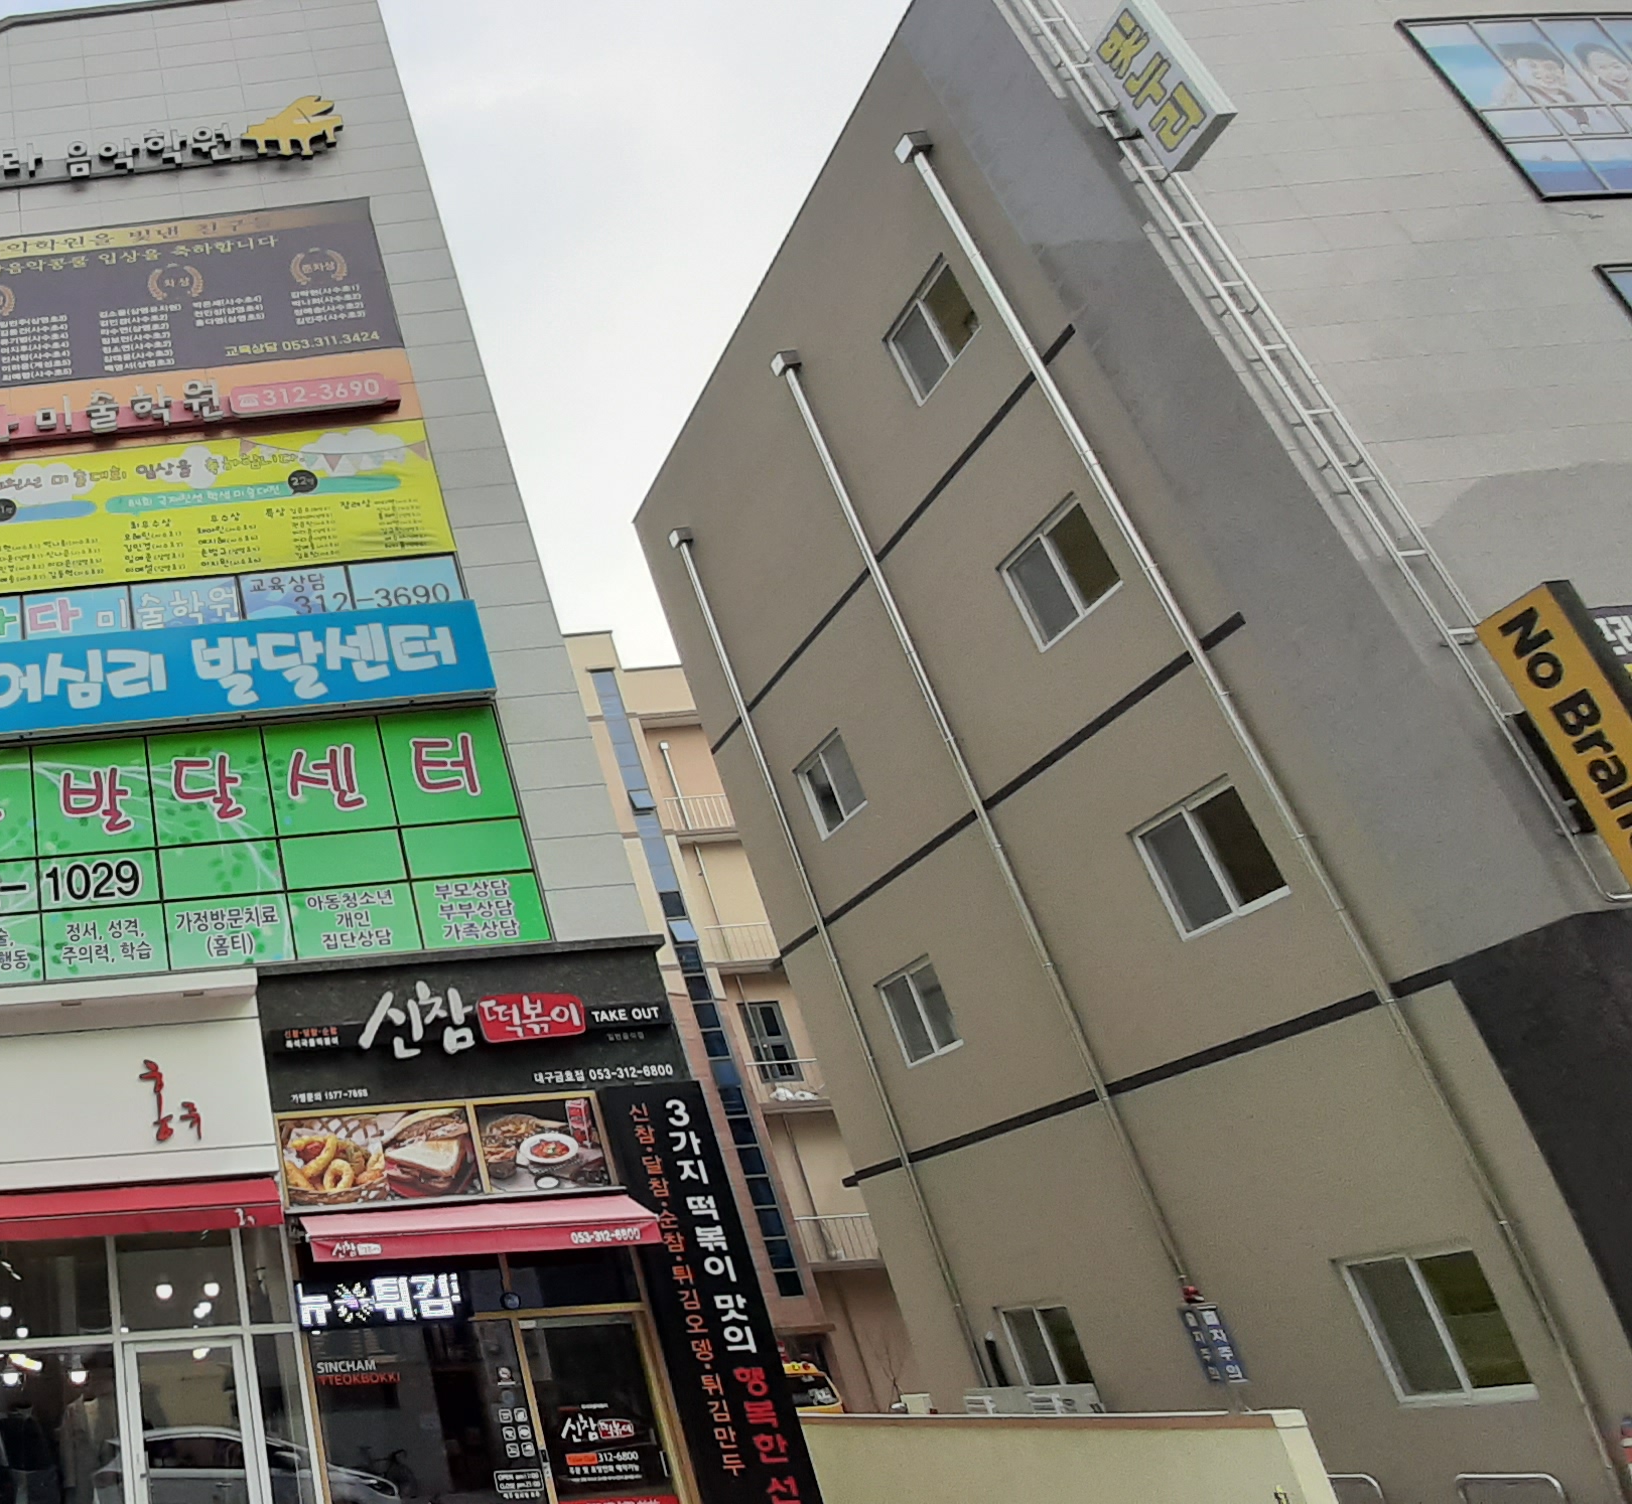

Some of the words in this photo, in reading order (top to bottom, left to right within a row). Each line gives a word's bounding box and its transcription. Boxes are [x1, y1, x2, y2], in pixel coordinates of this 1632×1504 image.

[67, 123, 233, 177] 음악학원
[281, 330, 380, 351] 053.311.3424
[35, 378, 224, 434] 미술학원
[263, 379, 381, 407] 312-3690
[135, 458, 192, 480] 입상을
[249, 573, 326, 595] 교육상담
[294, 582, 451, 615] 312-3690
[192, 622, 459, 707] 발달센터
[1498, 606, 1564, 690] No
[1549, 688, 1632, 856] Bra
[307, 888, 395, 912] 아동청소년
[434, 878, 511, 901] 부모상담
[175, 907, 280, 934] 가정방문치료
[336, 909, 371, 929] 개인
[438, 899, 516, 921] 부부상담
[66, 921, 103, 942] 정서,
[108, 917, 146, 940] 성격,
[322, 928, 392, 950] 집단상담
[443, 919, 522, 943] 가족상담
[61, 943, 116, 965] 주의력,
[119, 939, 153, 961] 학습
[206, 932, 256, 958] (홈티)
[358, 981, 476, 1060] 신참
[480, 995, 583, 1038] 떡볶이
[592, 1008, 629, 1023] TAKE
[631, 1006, 659, 1020] OUT
[534, 1070, 585, 1085] 대구금호점
[588, 1063, 674, 1081] 053-312-6800
[665, 1099, 709, 1185] 3가지
[571, 1227, 641, 1244] 053-312-6800
[686, 1195, 737, 1282] 떡볶이
[298, 1282, 332, 1328] 뉴
[713, 1293, 757, 1354] 맛의
[317, 1360, 377, 1374] SINCHAM
[561, 1413, 598, 1443] 신참
[733, 1366, 790, 1464] 행복한
[598, 1451, 639, 1463] 312-6800
